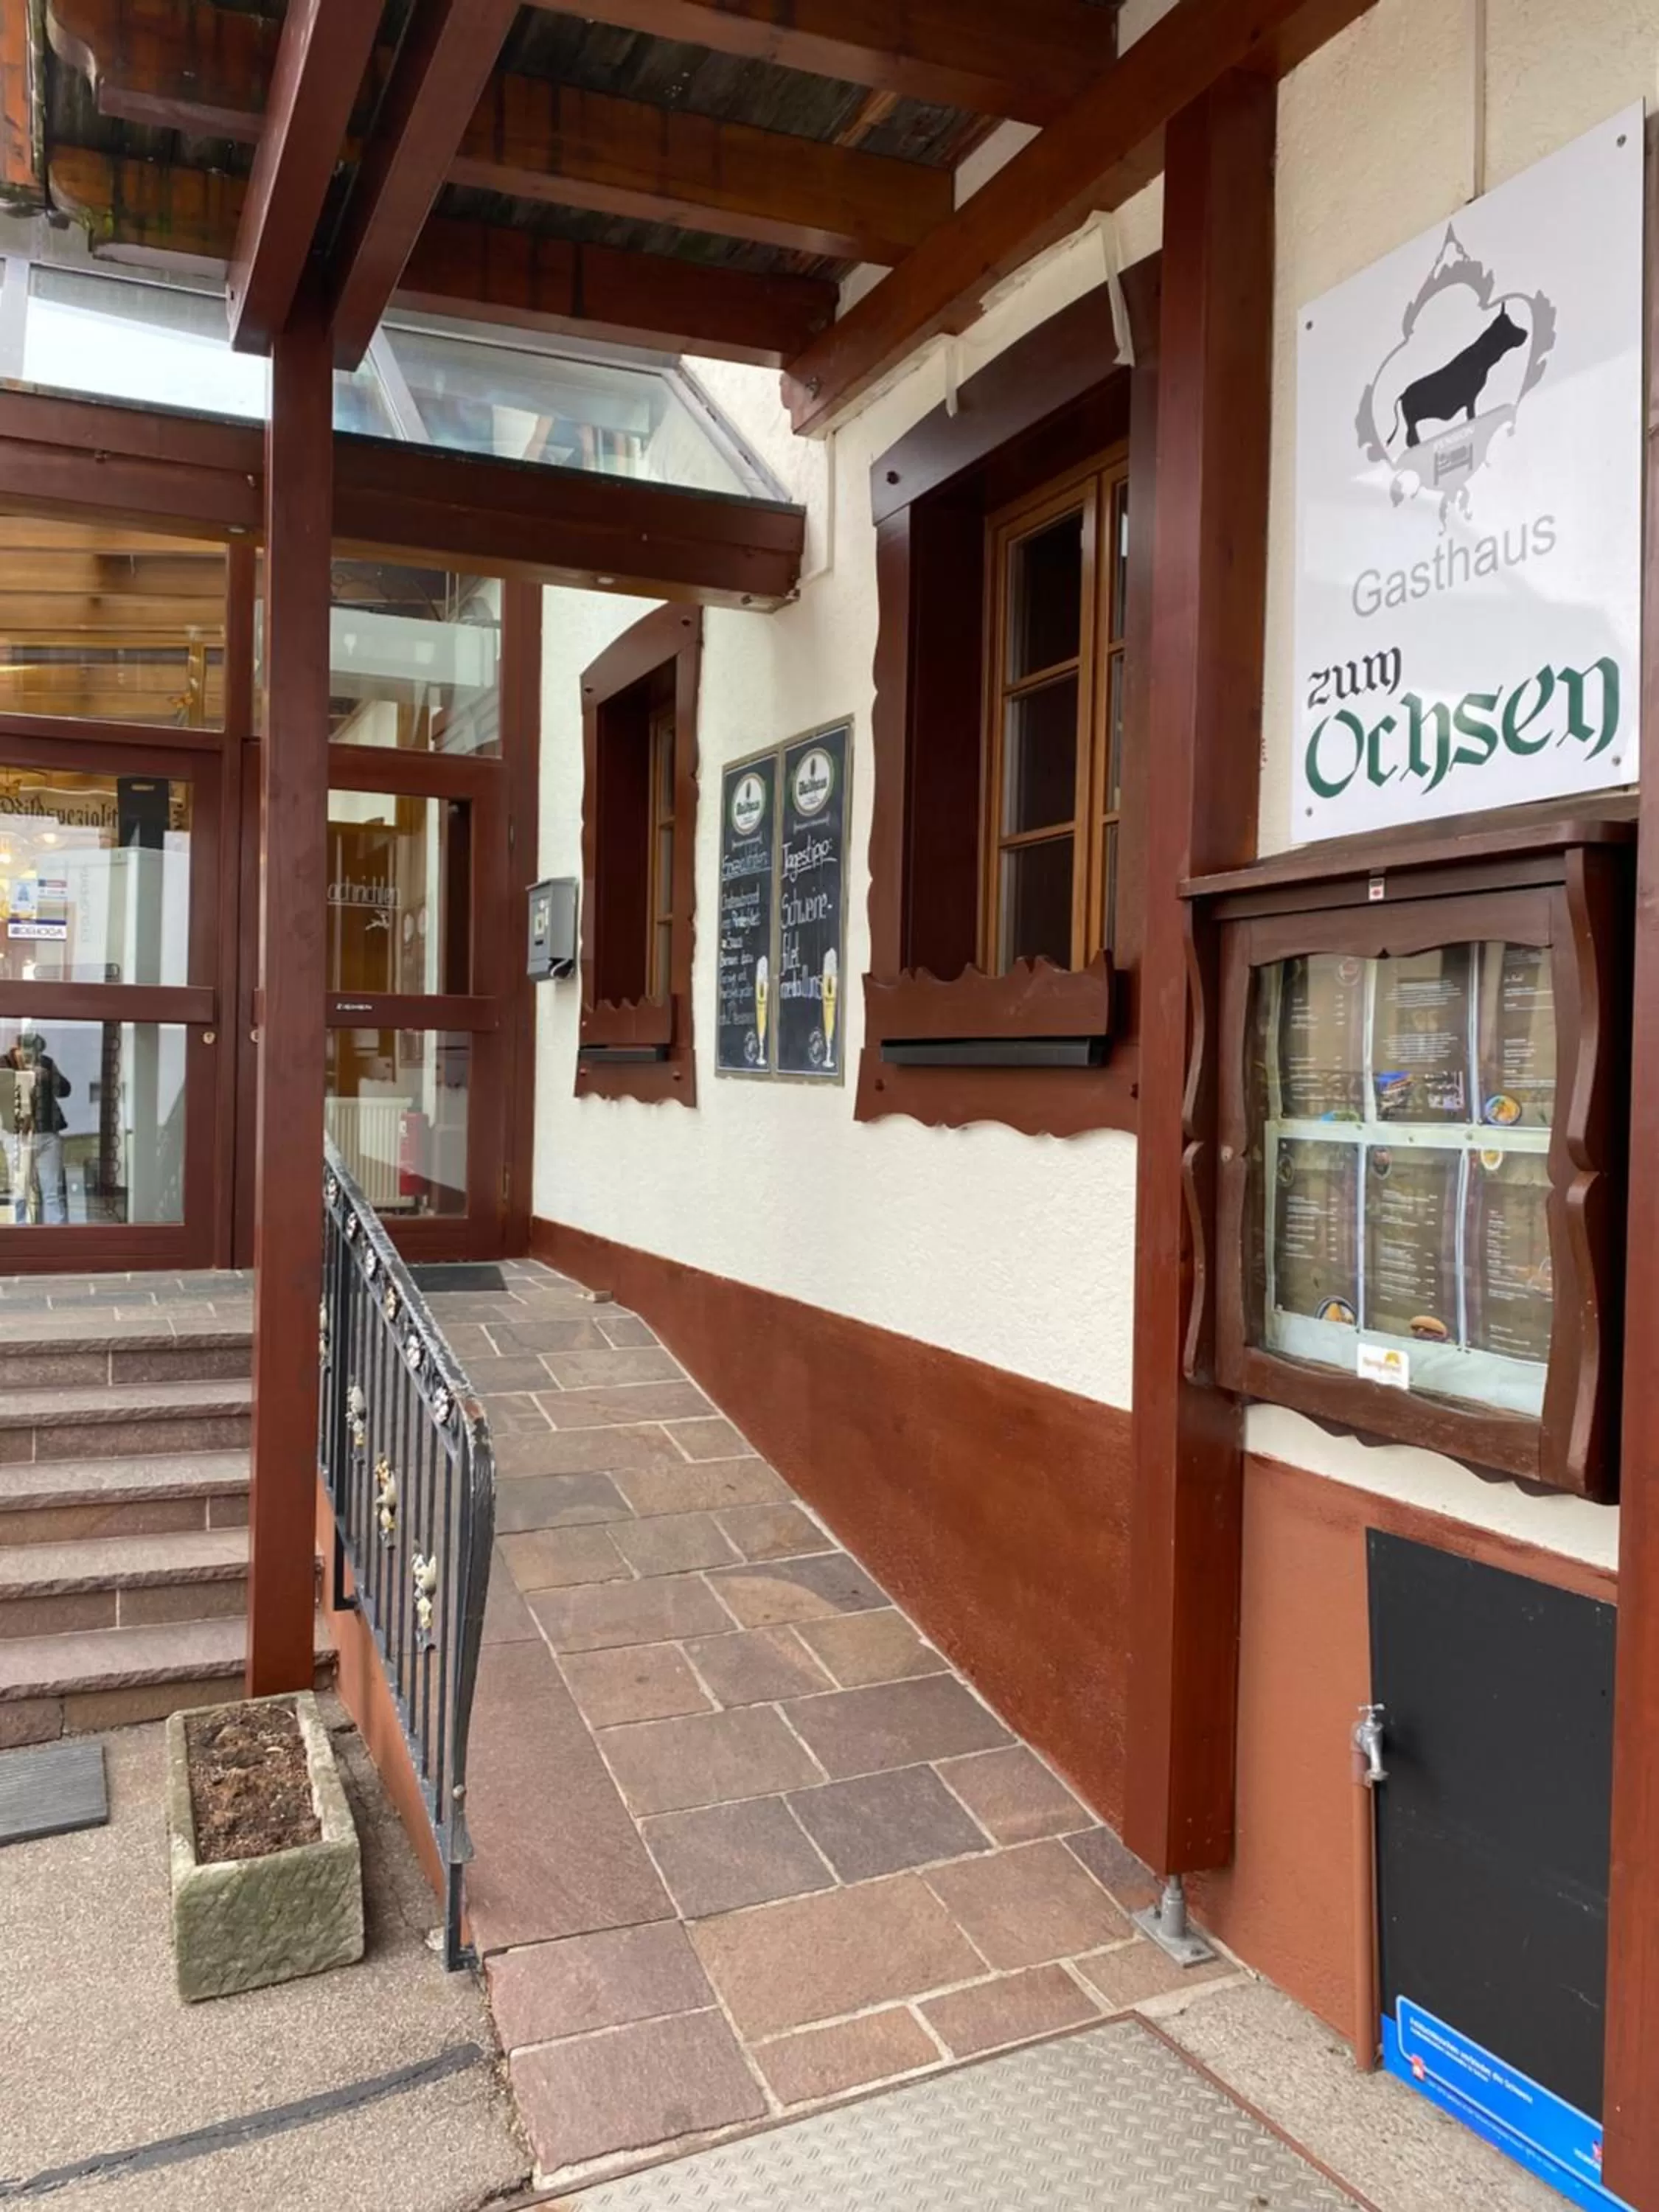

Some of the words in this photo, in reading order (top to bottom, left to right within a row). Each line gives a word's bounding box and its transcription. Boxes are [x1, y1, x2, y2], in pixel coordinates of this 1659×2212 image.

[1352, 515, 1557, 617] Gasthaus
[1304, 656, 1620, 799] Ochsen
[1307, 646, 1402, 709] zum
